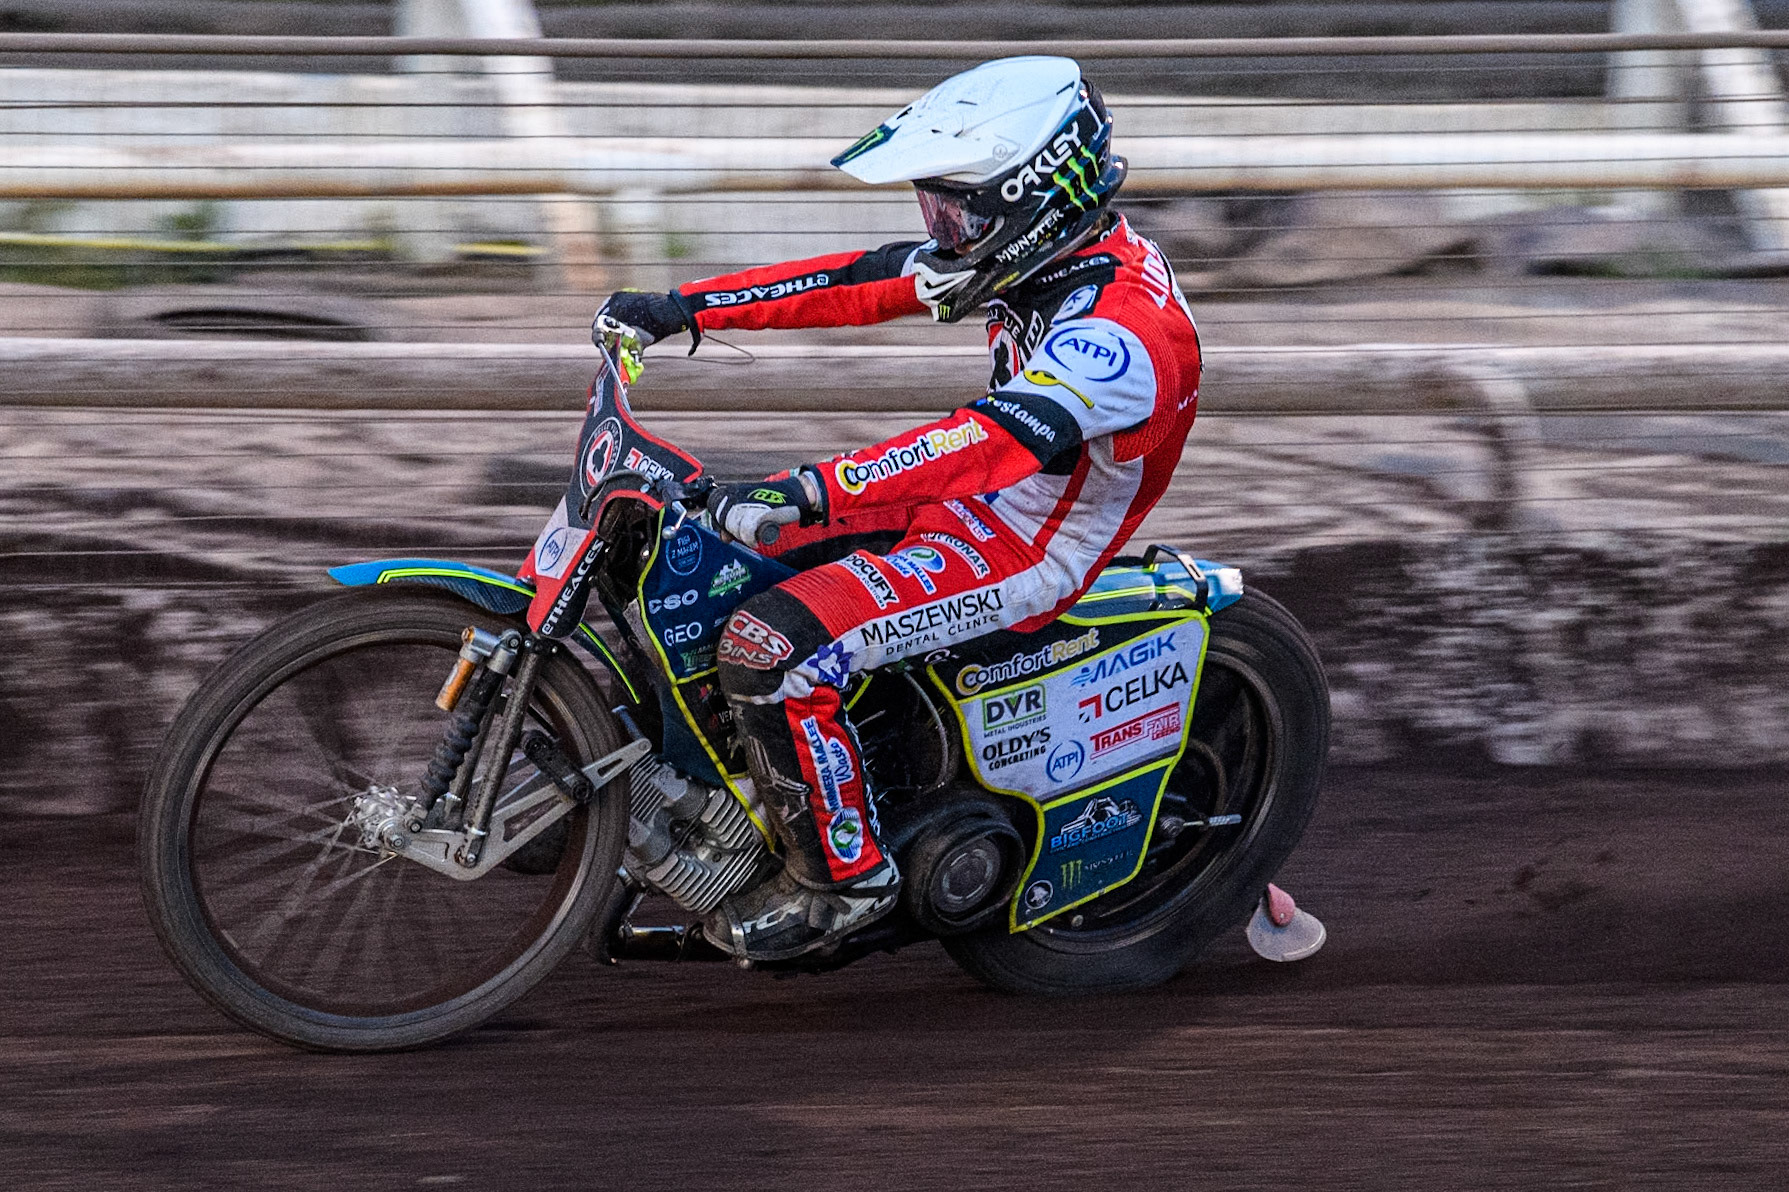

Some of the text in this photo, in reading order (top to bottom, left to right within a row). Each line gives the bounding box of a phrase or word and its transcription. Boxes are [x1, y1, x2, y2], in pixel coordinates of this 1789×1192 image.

[1001, 120, 1082, 202] OAKLEY
[1058, 337, 1117, 367] ATPI
[836, 418, 988, 493] ComfortRent
[664, 622, 702, 647] GEO
[860, 588, 1004, 646] MASZEWSKI
[886, 614, 1000, 655] DENTAL CLINIC
[718, 638, 771, 663] BINS
[729, 615, 788, 656] CBS
[956, 627, 1100, 695] ComfortRent
[1105, 661, 1188, 711] CELKA
[986, 690, 1043, 724] DVR
[982, 726, 1051, 762] OLDY'S
[989, 746, 1046, 771] CONCRETING
[1052, 751, 1080, 771] ATPI
[1051, 812, 1129, 848] BIGFOOT
